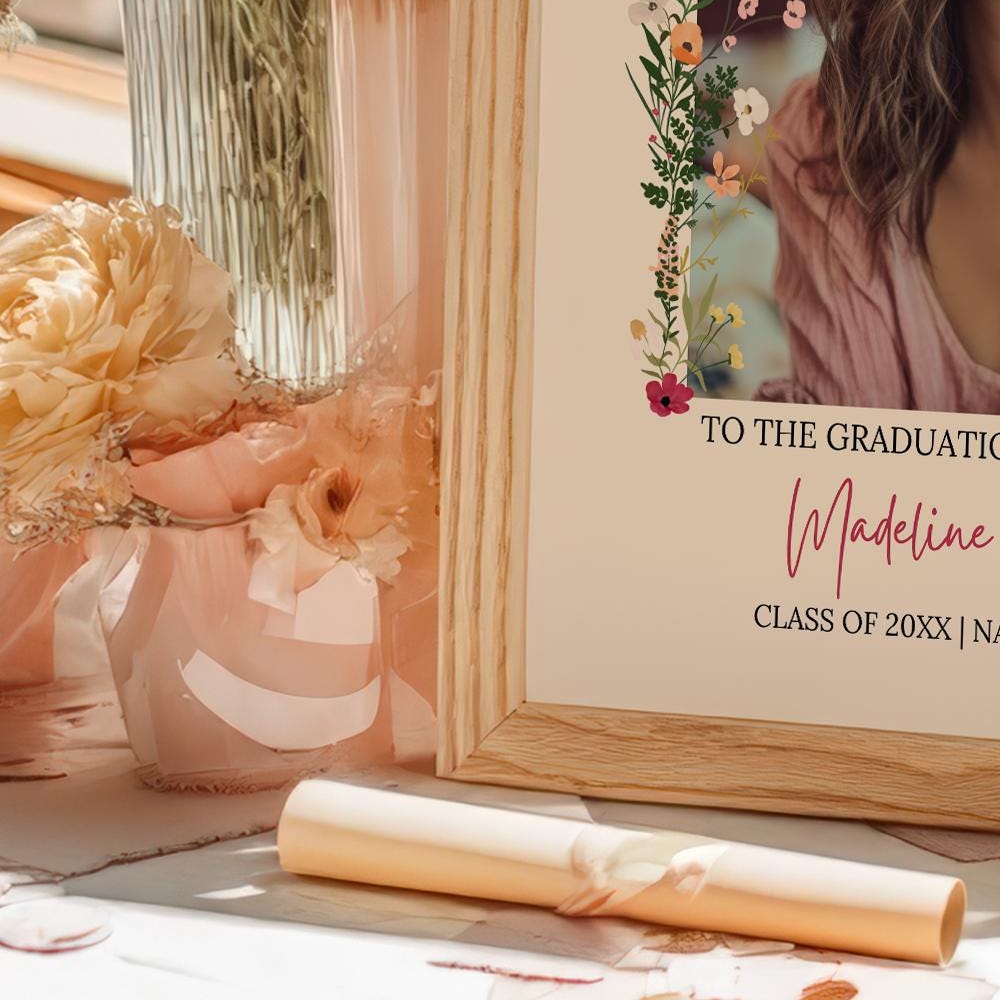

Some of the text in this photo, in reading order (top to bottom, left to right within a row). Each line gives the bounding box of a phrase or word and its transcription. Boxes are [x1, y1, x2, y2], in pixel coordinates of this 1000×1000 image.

[701, 416, 745, 445] TO
[754, 419, 817, 449] THE
[786, 478, 993, 600] Madeline
[753, 603, 834, 634] CLASS
[842, 609, 879, 635] OF
[885, 612, 952, 641] 20XX
